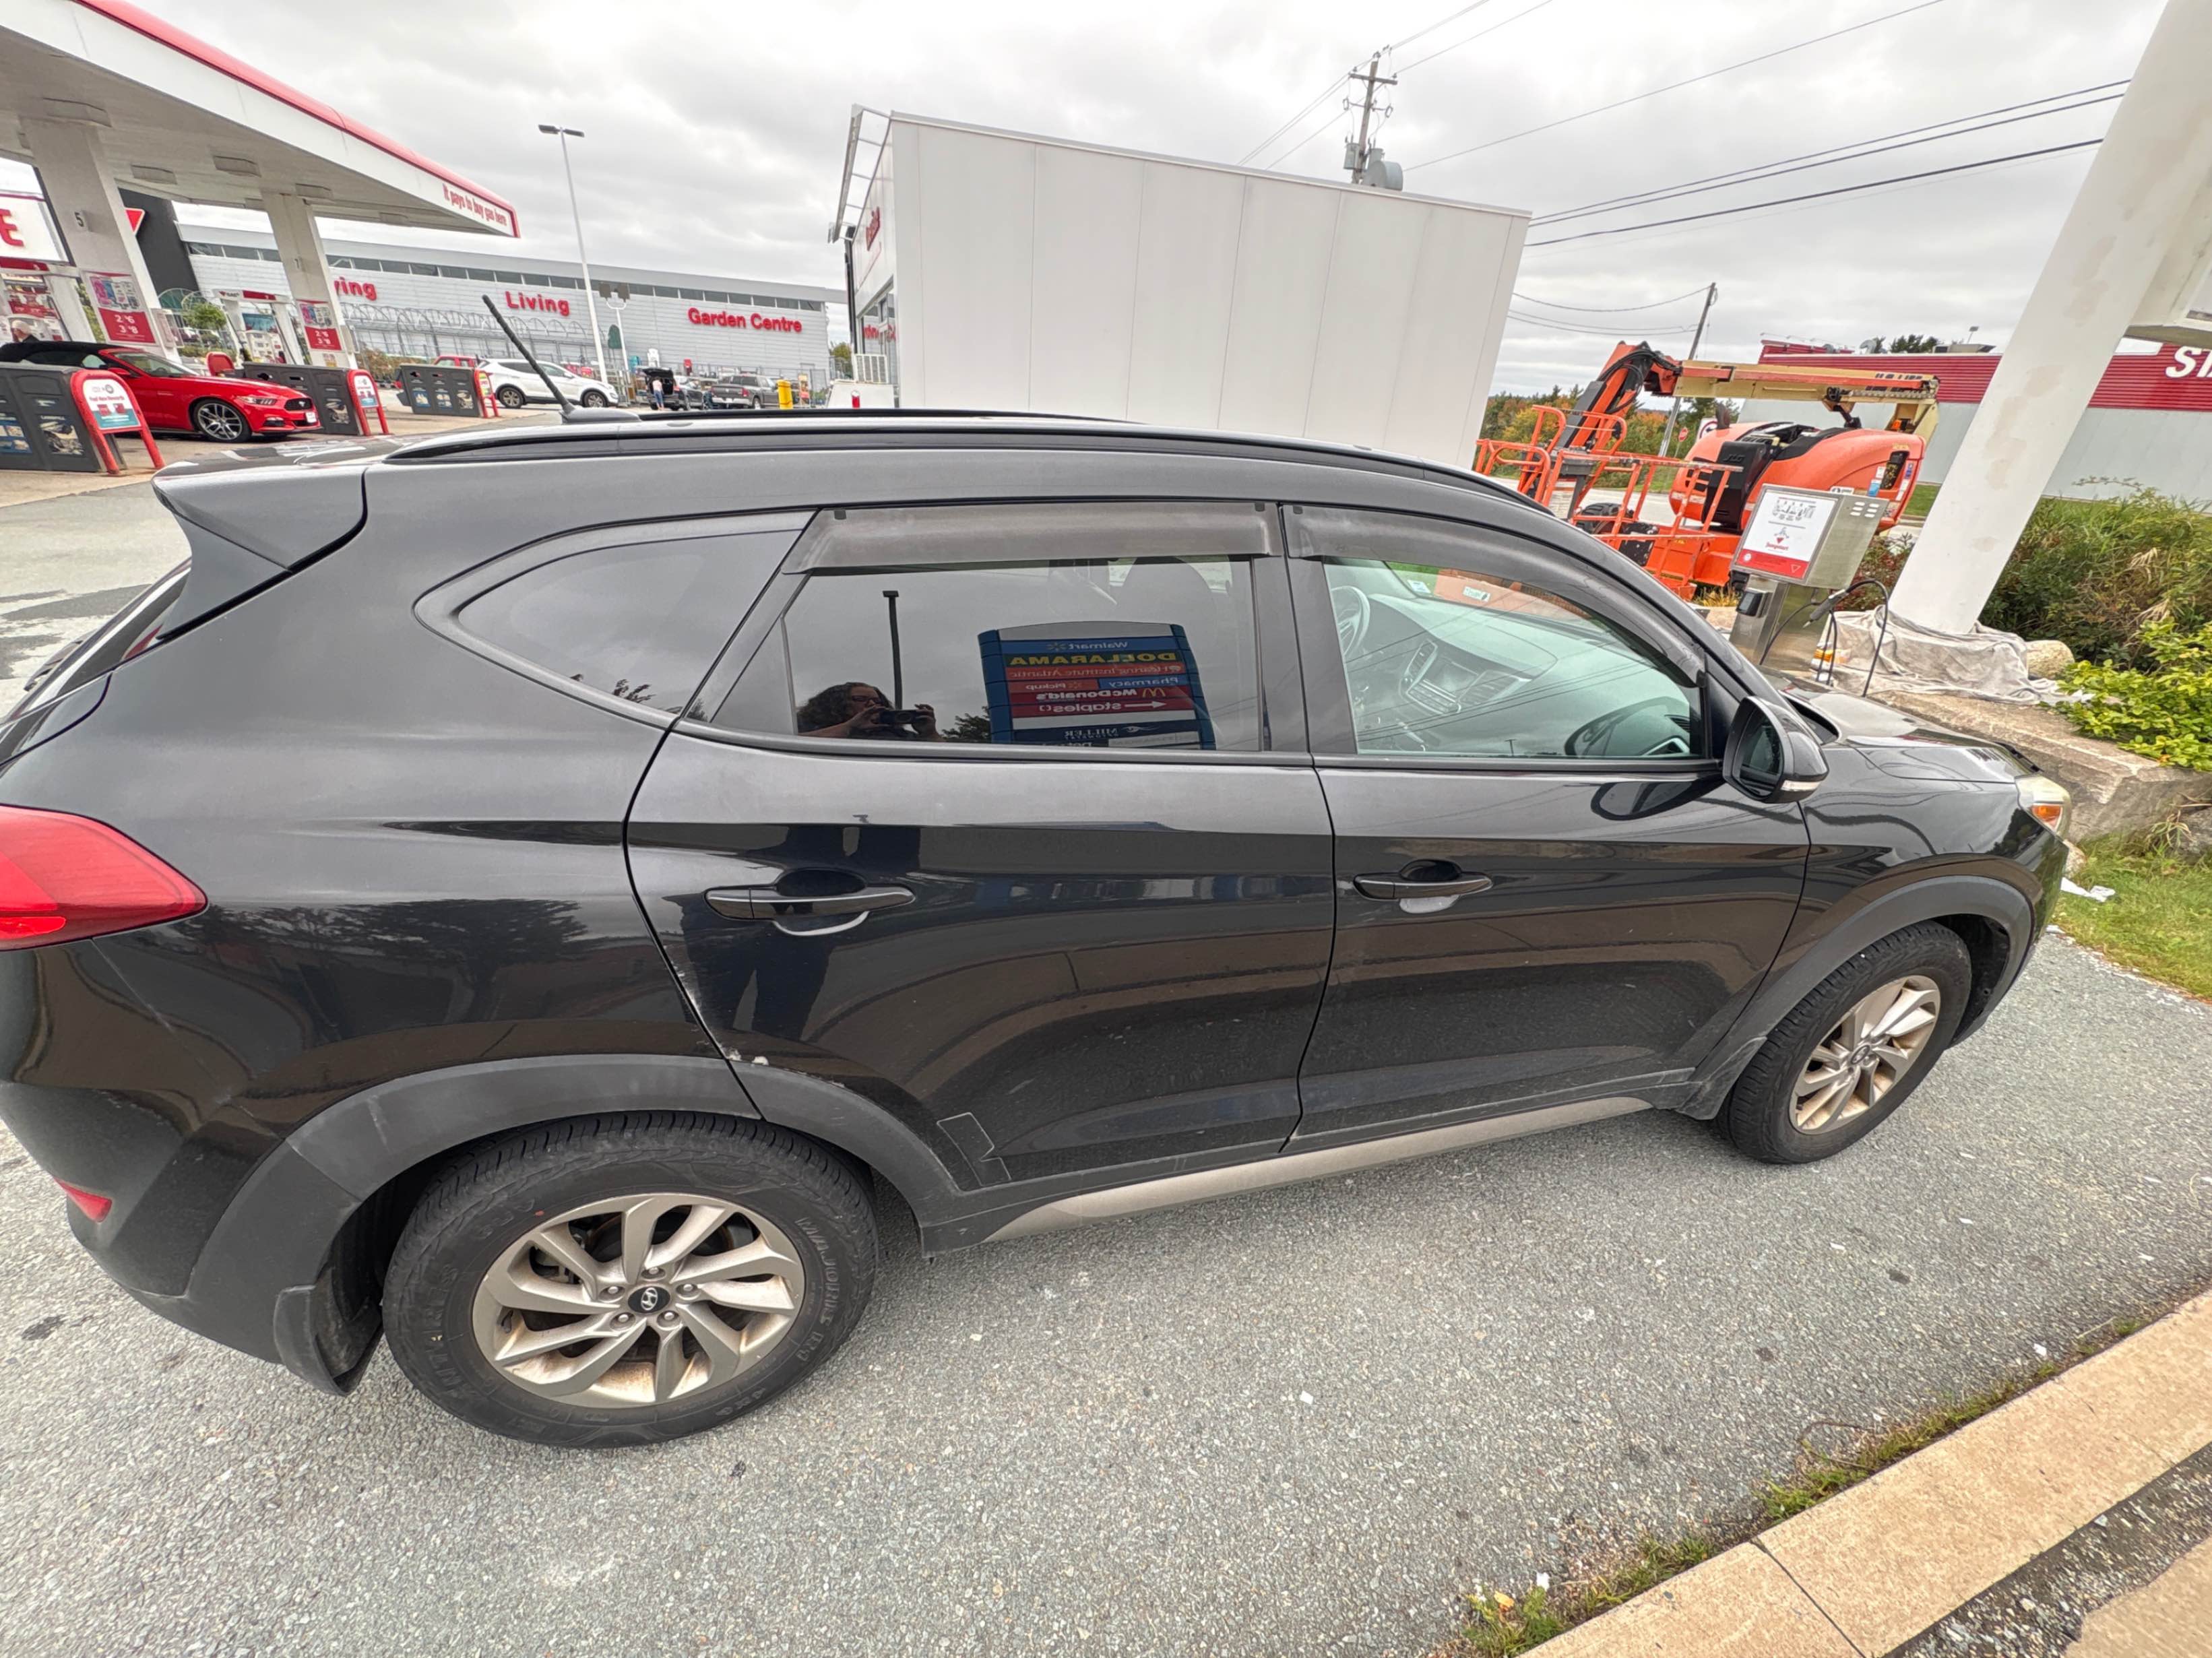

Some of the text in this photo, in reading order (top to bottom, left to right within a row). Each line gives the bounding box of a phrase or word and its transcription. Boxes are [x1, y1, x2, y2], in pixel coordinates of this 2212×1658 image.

[443, 183, 449, 201] It
[450, 191, 465, 210] pays
[473, 198, 484, 219] buy
[484, 208, 495, 222] gas
[494, 208, 507, 226] here
[74, 211, 84, 227] 5
[505, 291, 570, 317] Living
[688, 307, 802, 333] Garden Centre
[2166, 346, 2212, 378] ST
